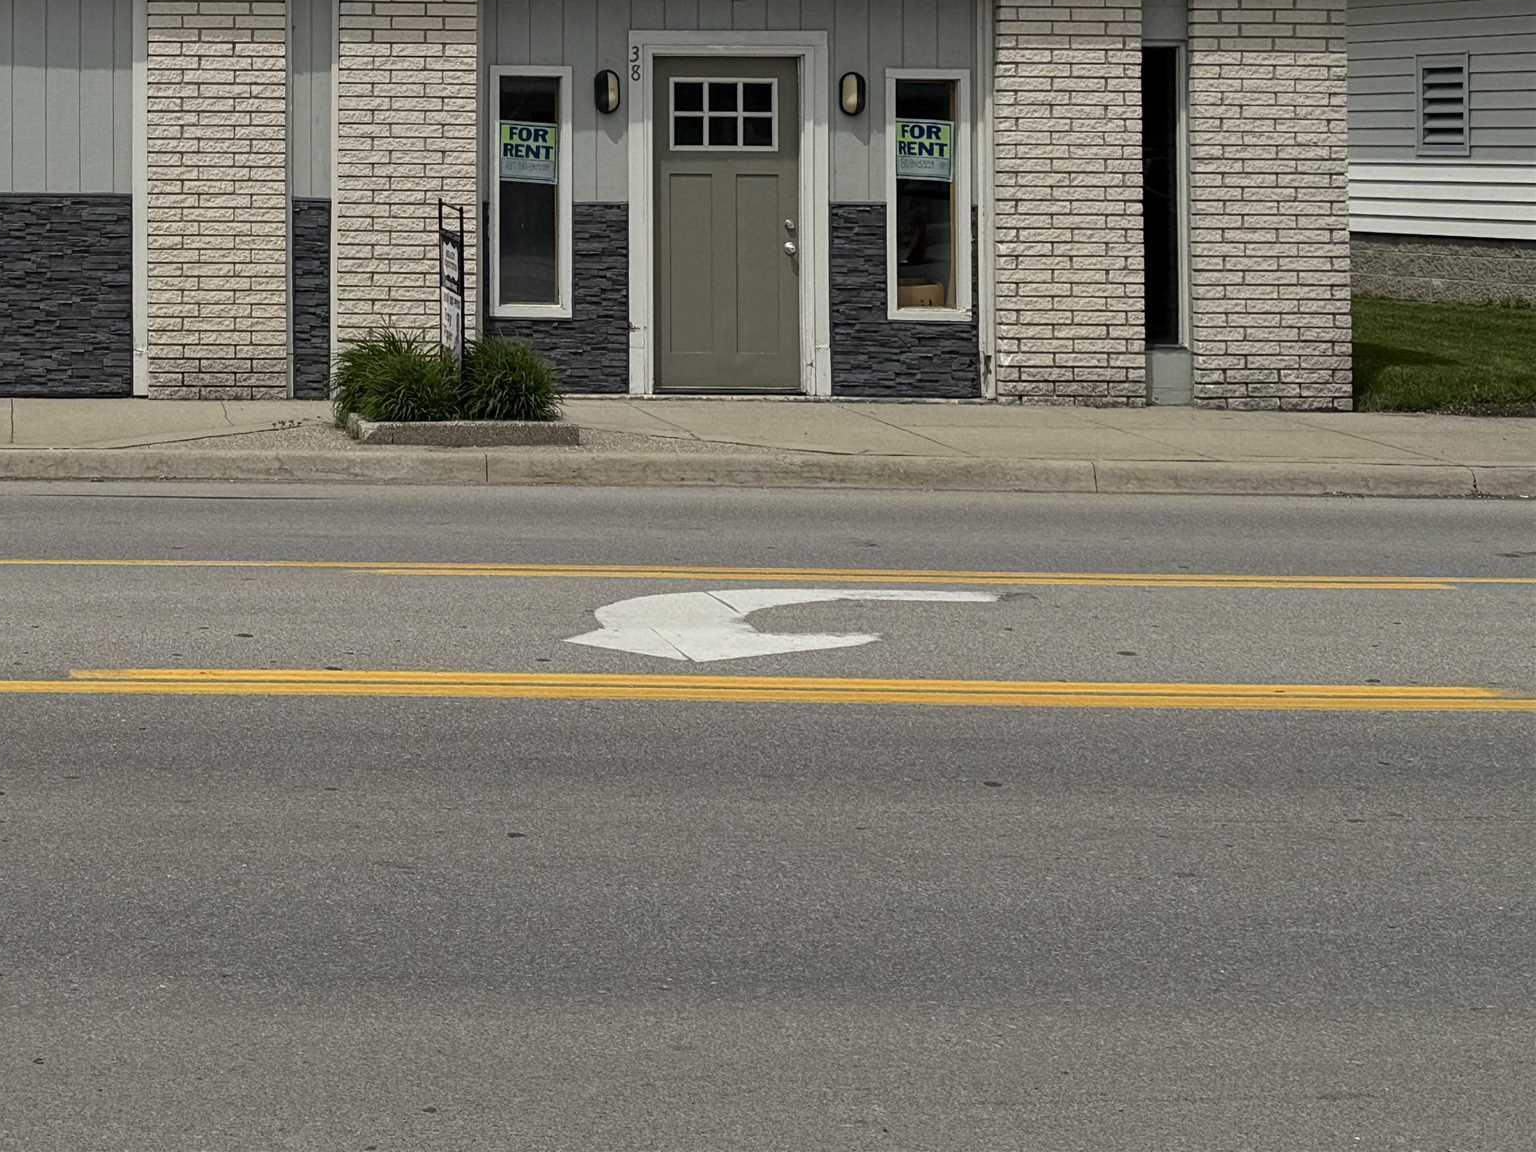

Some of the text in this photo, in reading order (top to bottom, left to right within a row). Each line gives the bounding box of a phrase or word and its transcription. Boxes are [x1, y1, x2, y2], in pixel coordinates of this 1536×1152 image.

[630, 46, 641, 82] 38
[509, 126, 549, 143] FOR
[901, 124, 942, 140] FOR
[503, 142, 554, 160] RENT
[898, 141, 948, 157] RENT
